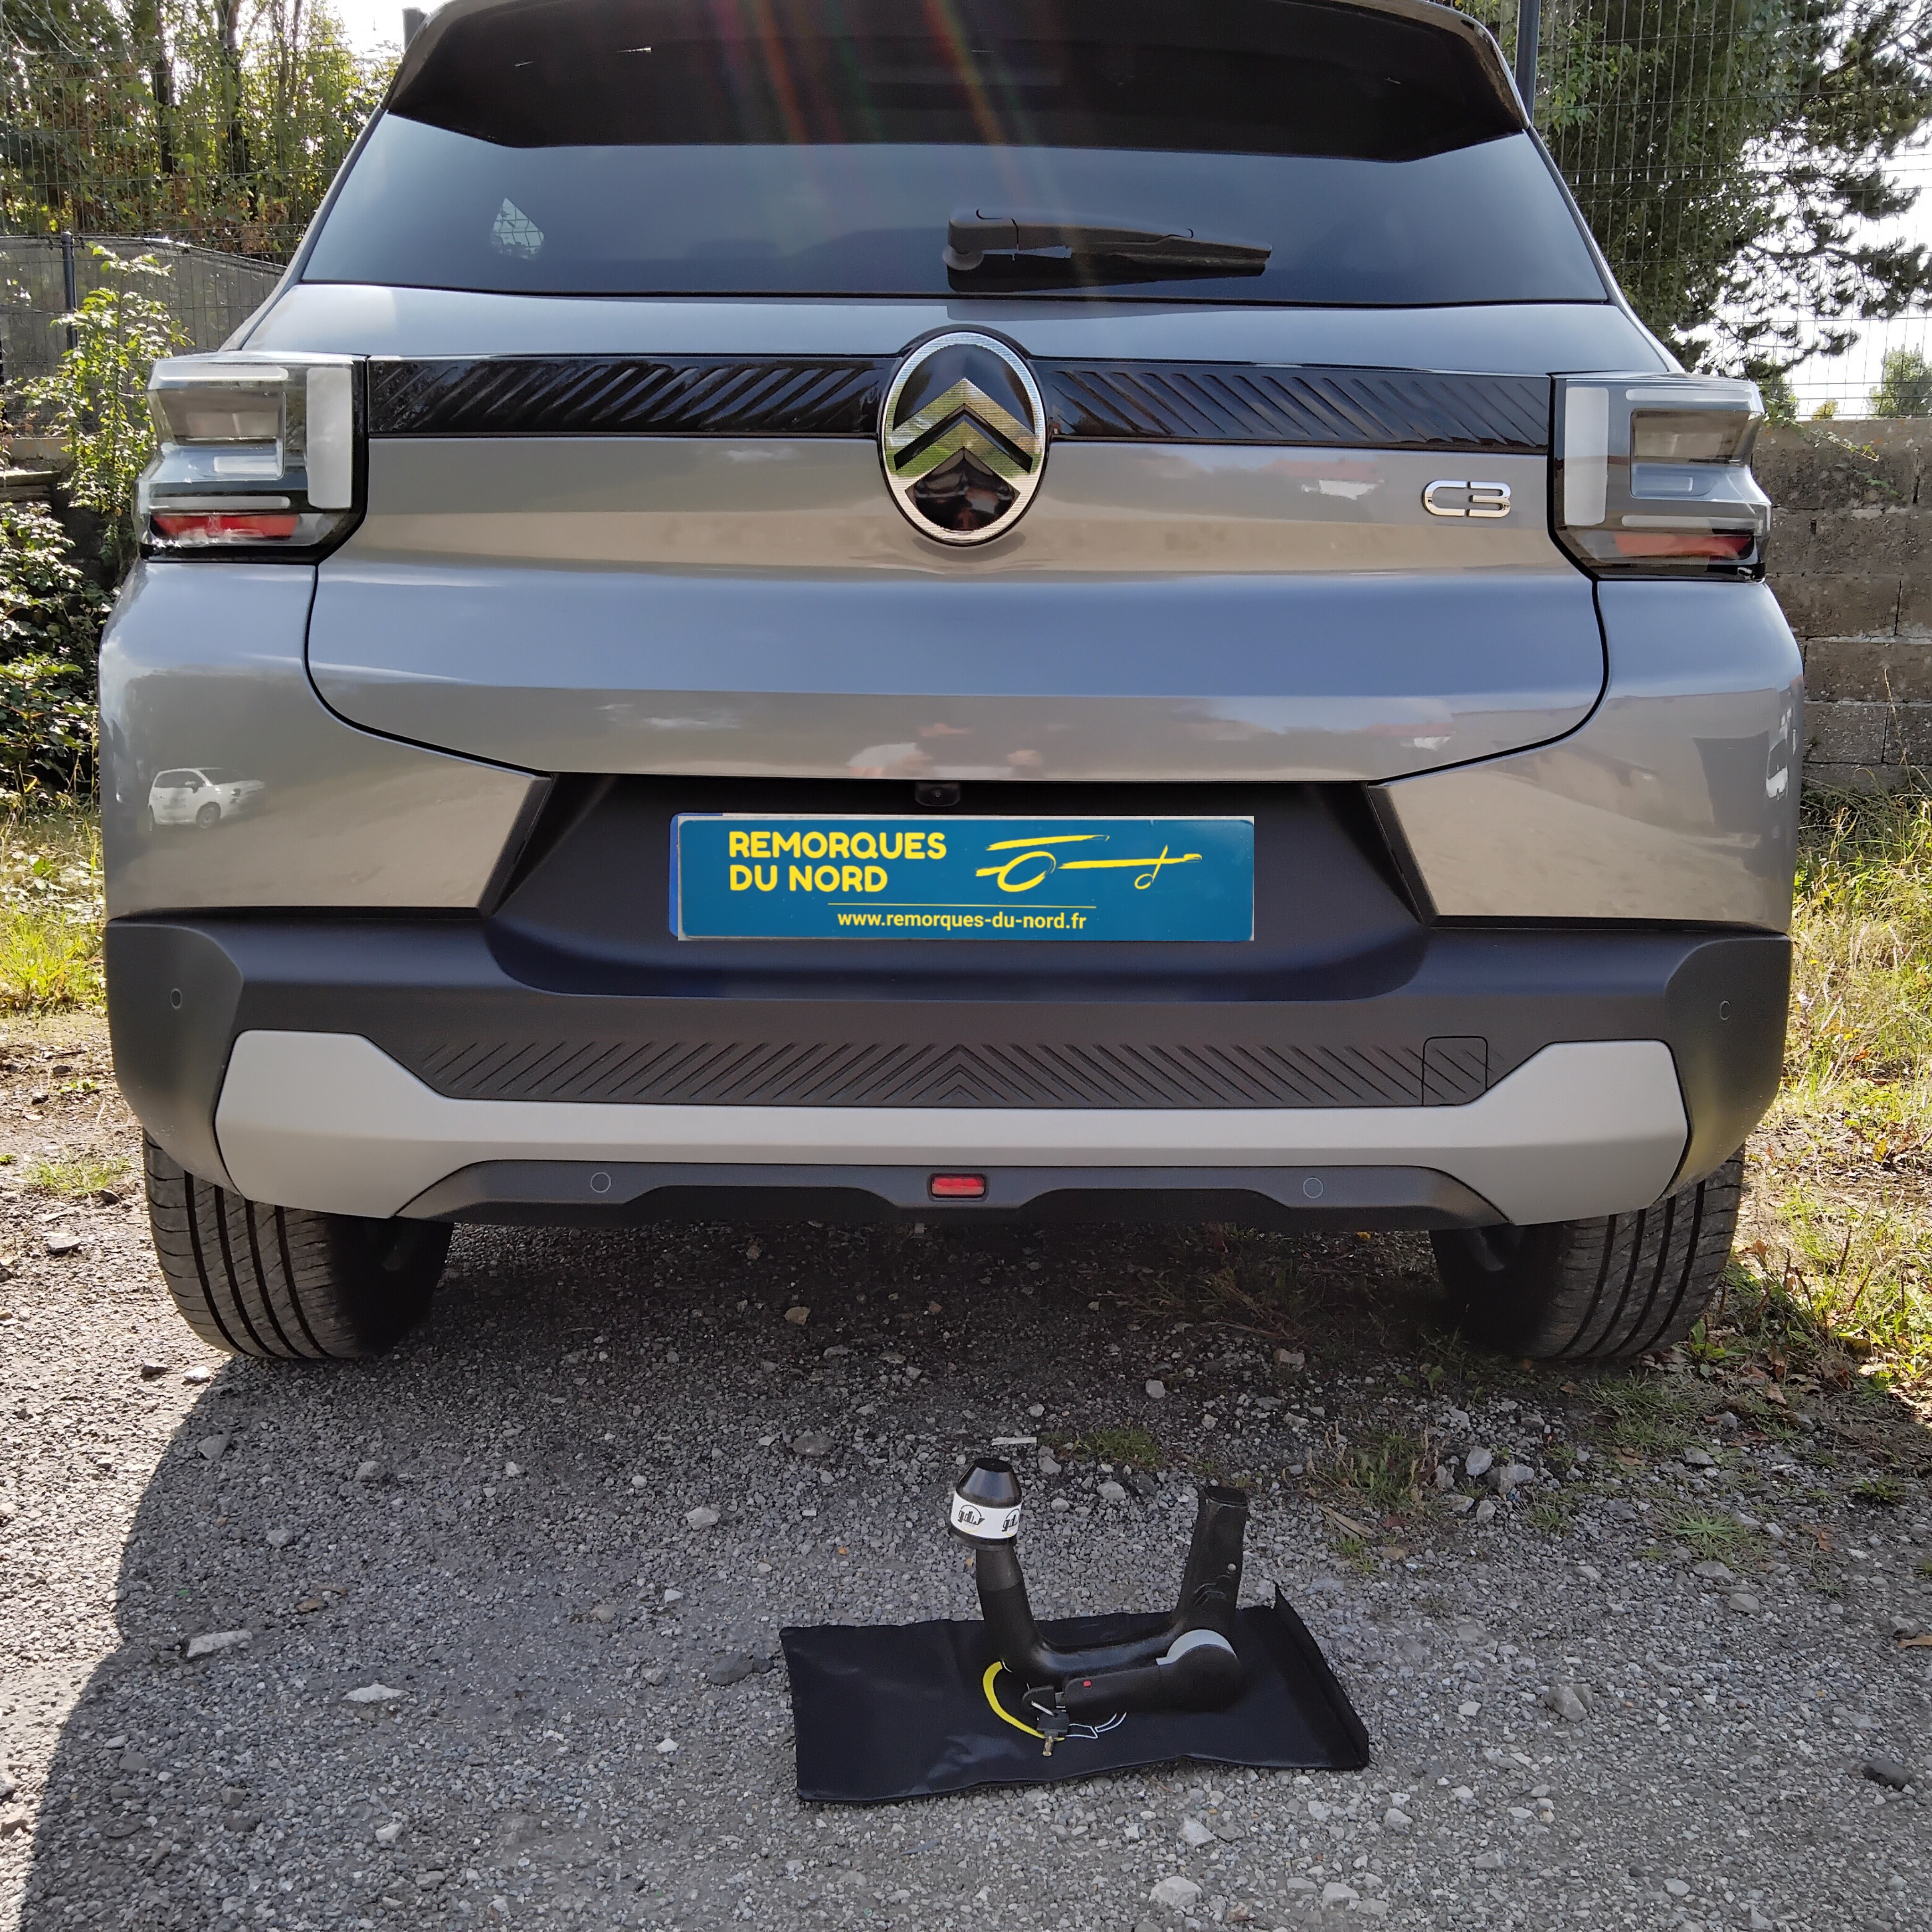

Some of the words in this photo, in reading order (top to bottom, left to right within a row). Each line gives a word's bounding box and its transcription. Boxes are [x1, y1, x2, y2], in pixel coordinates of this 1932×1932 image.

[1421, 480, 1511, 517] C3
[729, 831, 947, 859] REMORQUES
[730, 865, 778, 891] DU
[789, 865, 888, 892] NORD
[837, 911, 1087, 931] www.remorques-du-nord.fr
